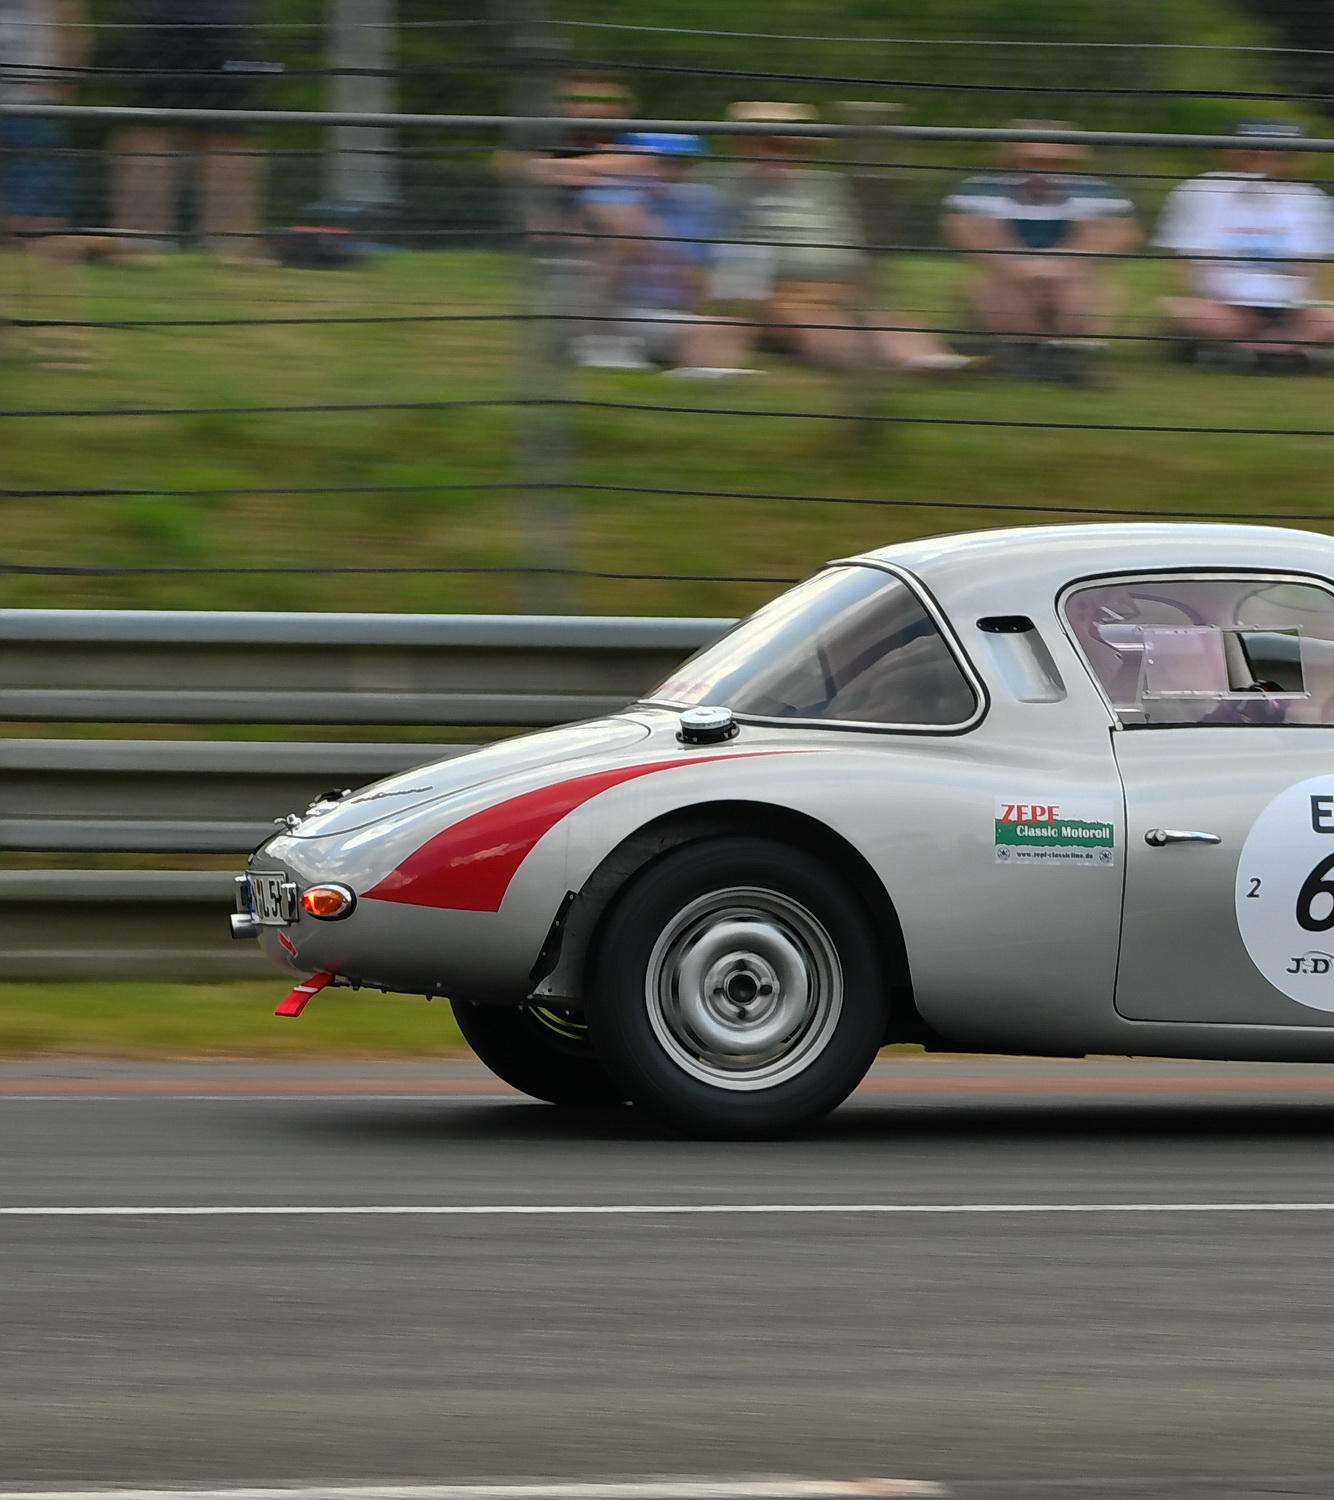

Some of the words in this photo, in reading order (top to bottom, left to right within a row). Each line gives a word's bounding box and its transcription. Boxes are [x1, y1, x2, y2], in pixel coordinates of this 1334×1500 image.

[1000, 803, 1060, 825] ZEPF
[1016, 824, 1058, 837] Classic
[1061, 826, 1110, 839] Motoroil
[1247, 877, 1262, 898] 2
